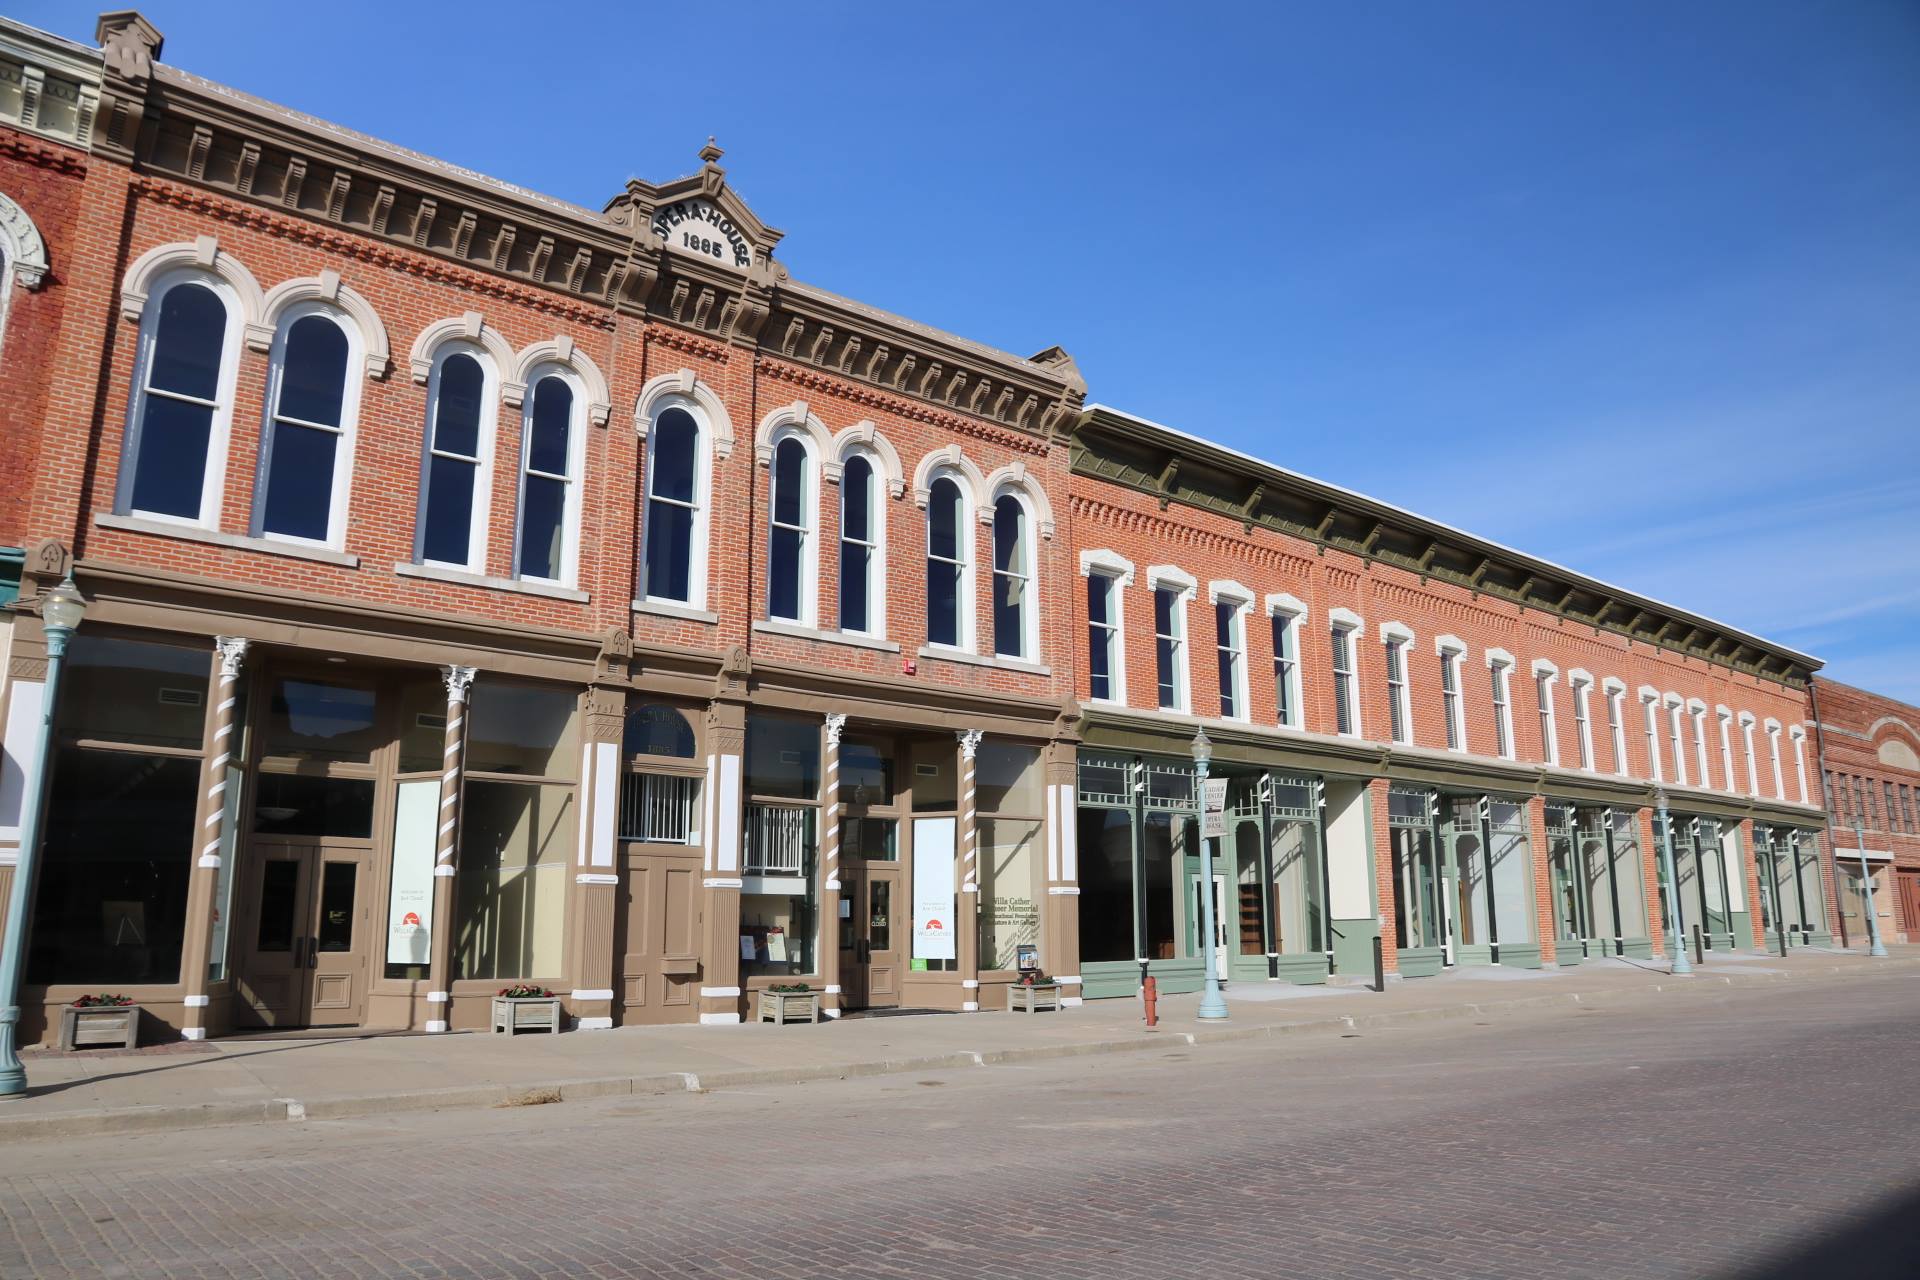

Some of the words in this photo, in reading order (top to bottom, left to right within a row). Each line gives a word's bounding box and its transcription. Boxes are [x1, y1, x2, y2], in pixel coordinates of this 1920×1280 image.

[683, 231, 723, 258] 1885
[706, 208, 751, 267] HOUSE
[1008, 904, 1039, 912] Memorial
[1009, 897, 1030, 905] Cather
